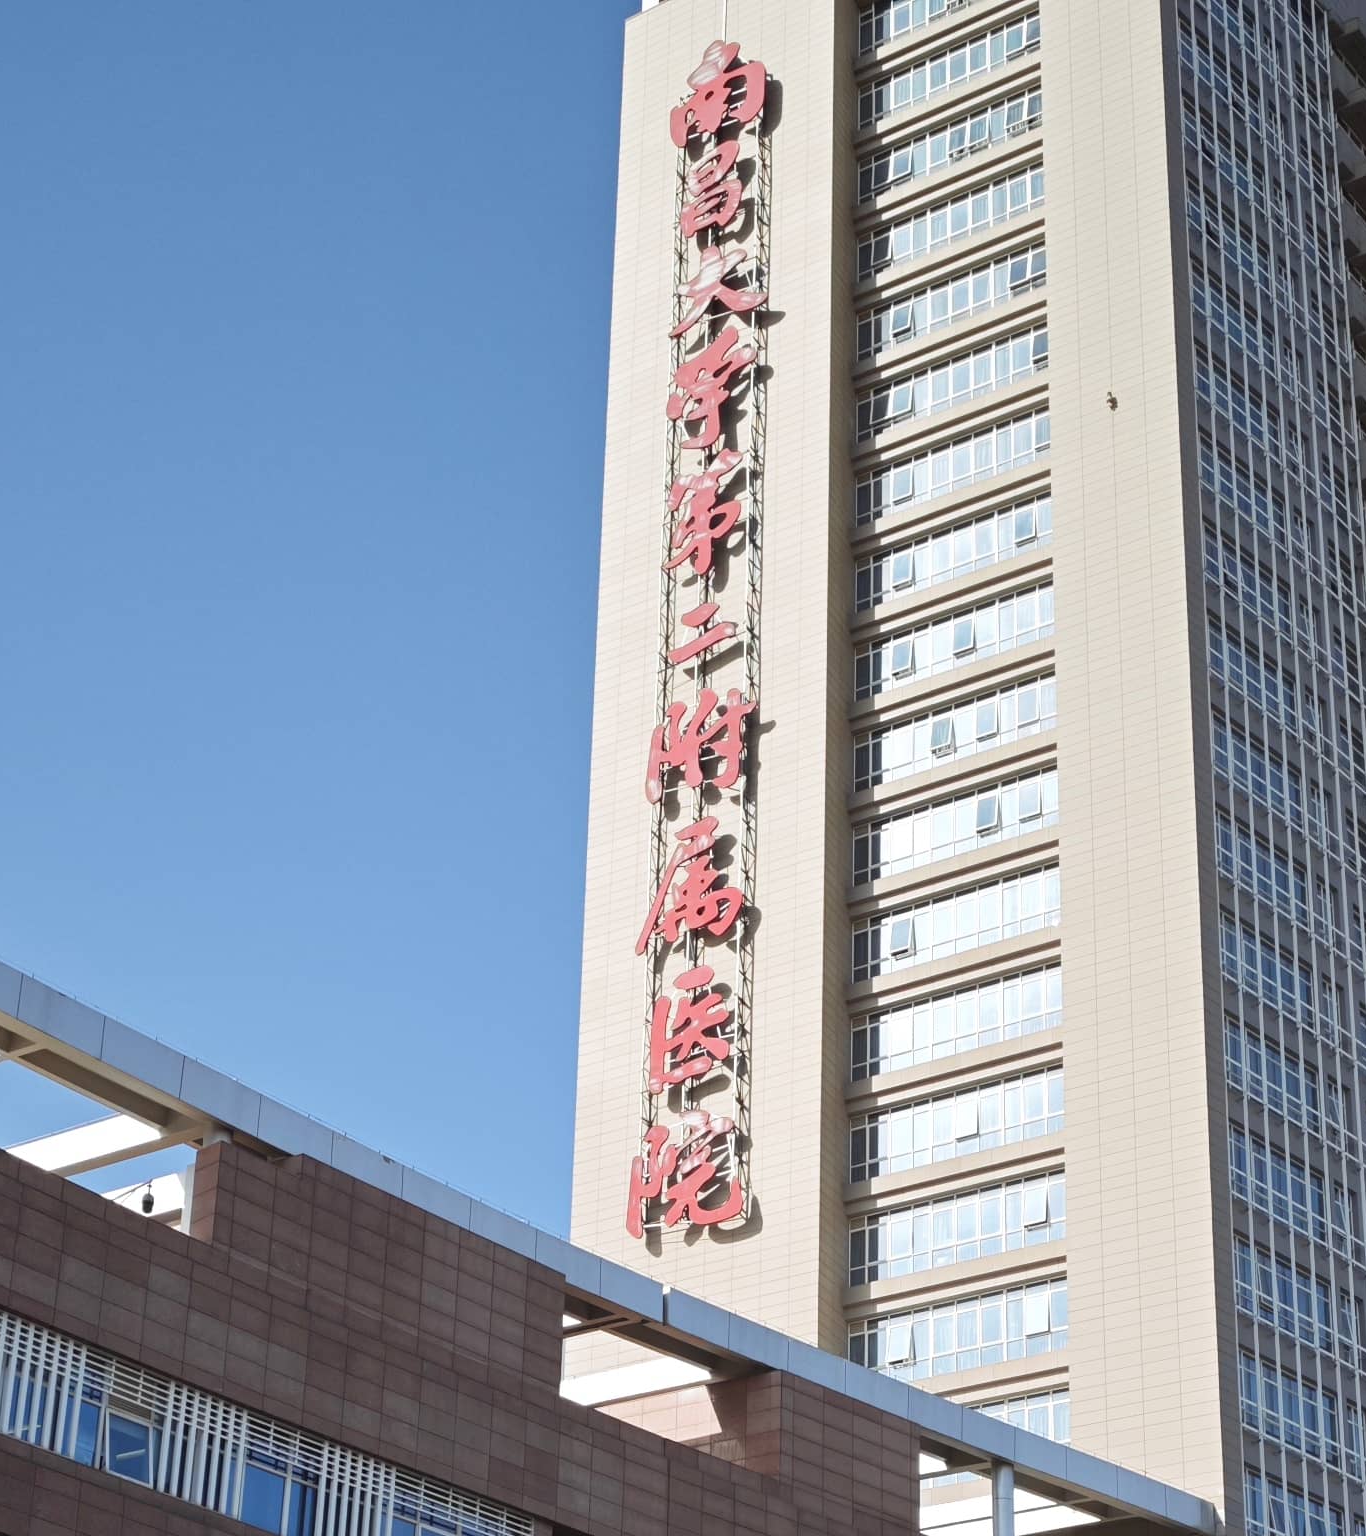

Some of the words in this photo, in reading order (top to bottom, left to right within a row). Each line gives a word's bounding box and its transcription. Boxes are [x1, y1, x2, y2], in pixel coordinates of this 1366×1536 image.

[623, 39, 768, 1239] 南昌大学第二附属医院
